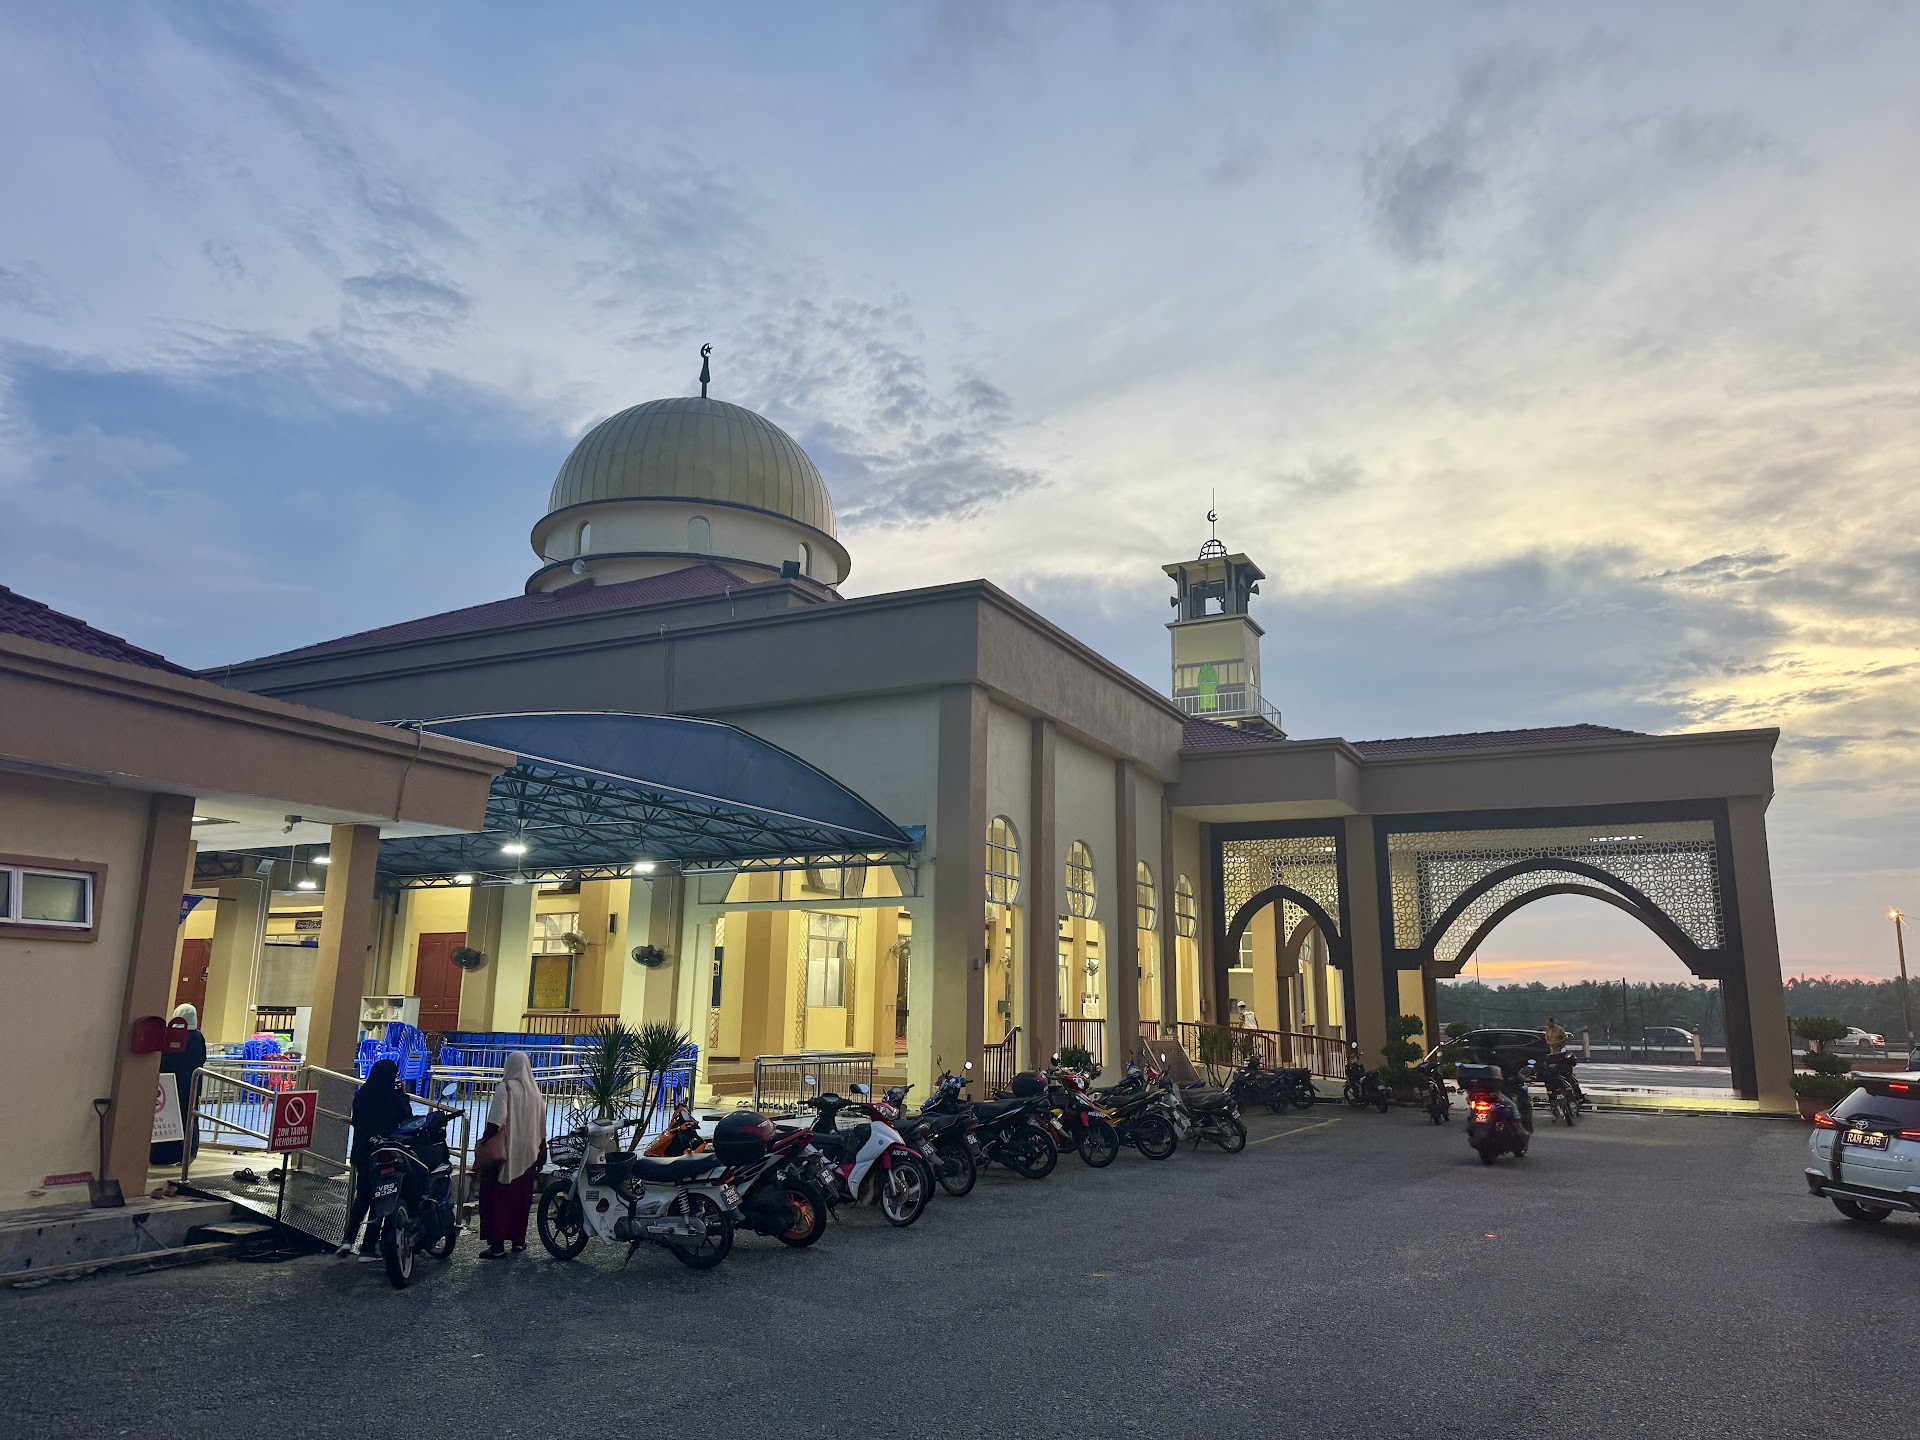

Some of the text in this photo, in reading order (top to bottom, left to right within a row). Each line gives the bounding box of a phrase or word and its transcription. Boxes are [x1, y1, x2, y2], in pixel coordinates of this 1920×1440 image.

[277, 1126, 308, 1137] ZON TANPA
[274, 1135, 309, 1148] KENDERAAN
[1847, 1133, 1881, 1146] RAM 2105
